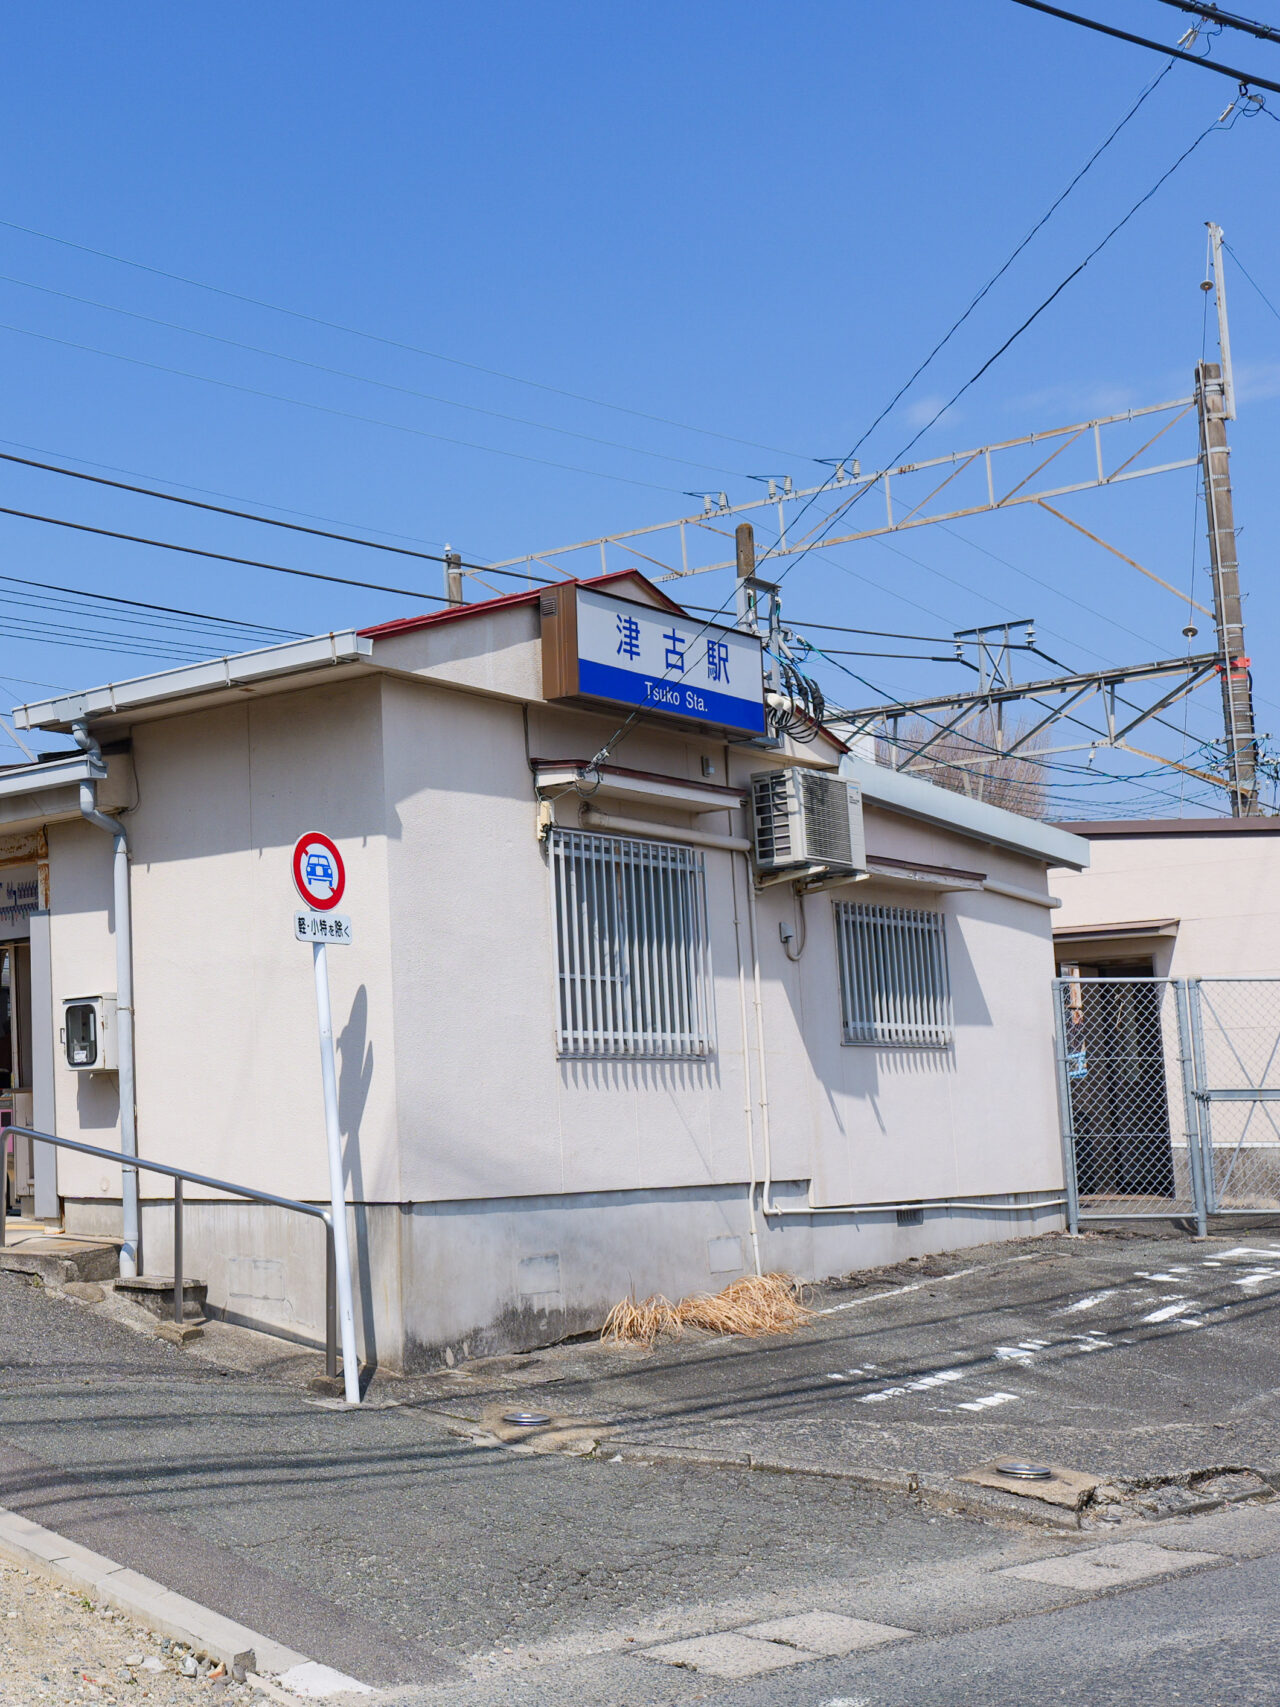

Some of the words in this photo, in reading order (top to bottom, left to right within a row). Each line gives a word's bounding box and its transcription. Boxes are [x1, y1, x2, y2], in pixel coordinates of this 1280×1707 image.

[616, 614, 730, 685] 津古駅
[645, 681, 680, 705] Tsuko
[686, 691, 708, 712] Sta.
[298, 917, 350, 938] 軽・小特を除く
